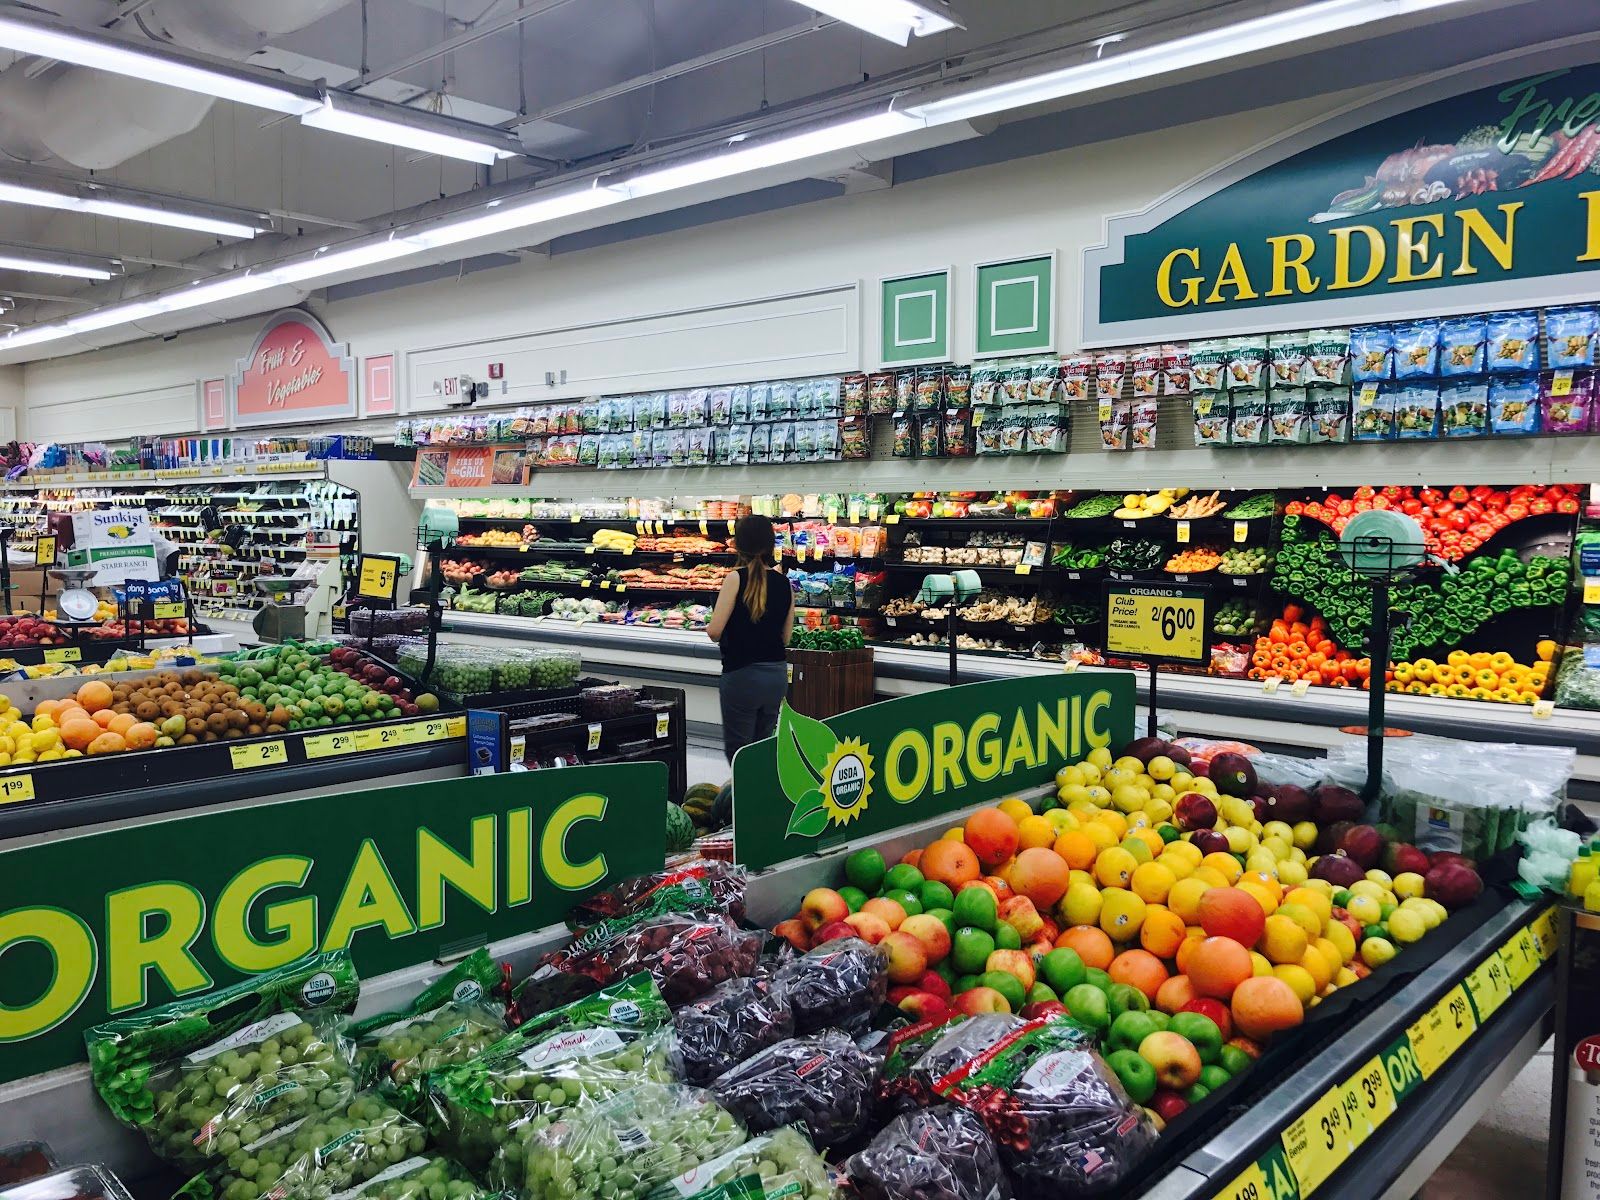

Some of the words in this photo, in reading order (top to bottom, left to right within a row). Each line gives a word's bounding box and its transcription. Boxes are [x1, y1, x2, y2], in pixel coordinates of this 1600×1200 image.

[1156, 201, 1525, 309] GARDEN
[261, 347, 286, 375] Fruit
[289, 339, 307, 367] &
[267, 364, 324, 408] Vegetables
[444, 377, 458, 396] EXIT
[460, 465, 486, 478] GRILL
[94, 511, 144, 526] Sunkist
[124, 560, 148, 568] RANCH
[127, 583, 145, 595] dang
[1129, 587, 1173, 597] ORGANIC
[1115, 597, 1135, 606] Club
[1112, 606, 1138, 616] Price!
[884, 689, 1113, 804] ORGANIC
[838, 765, 859, 782] USDA
[834, 780, 861, 796] ORGANIC
[0, 792, 608, 1043] ORGANIC
[309, 978, 330, 990] USDA
[456, 983, 473, 998] USDA
[204, 992, 226, 1005] Green
[306, 987, 333, 999] ORGANIC
[614, 1005, 633, 1014] USDA
